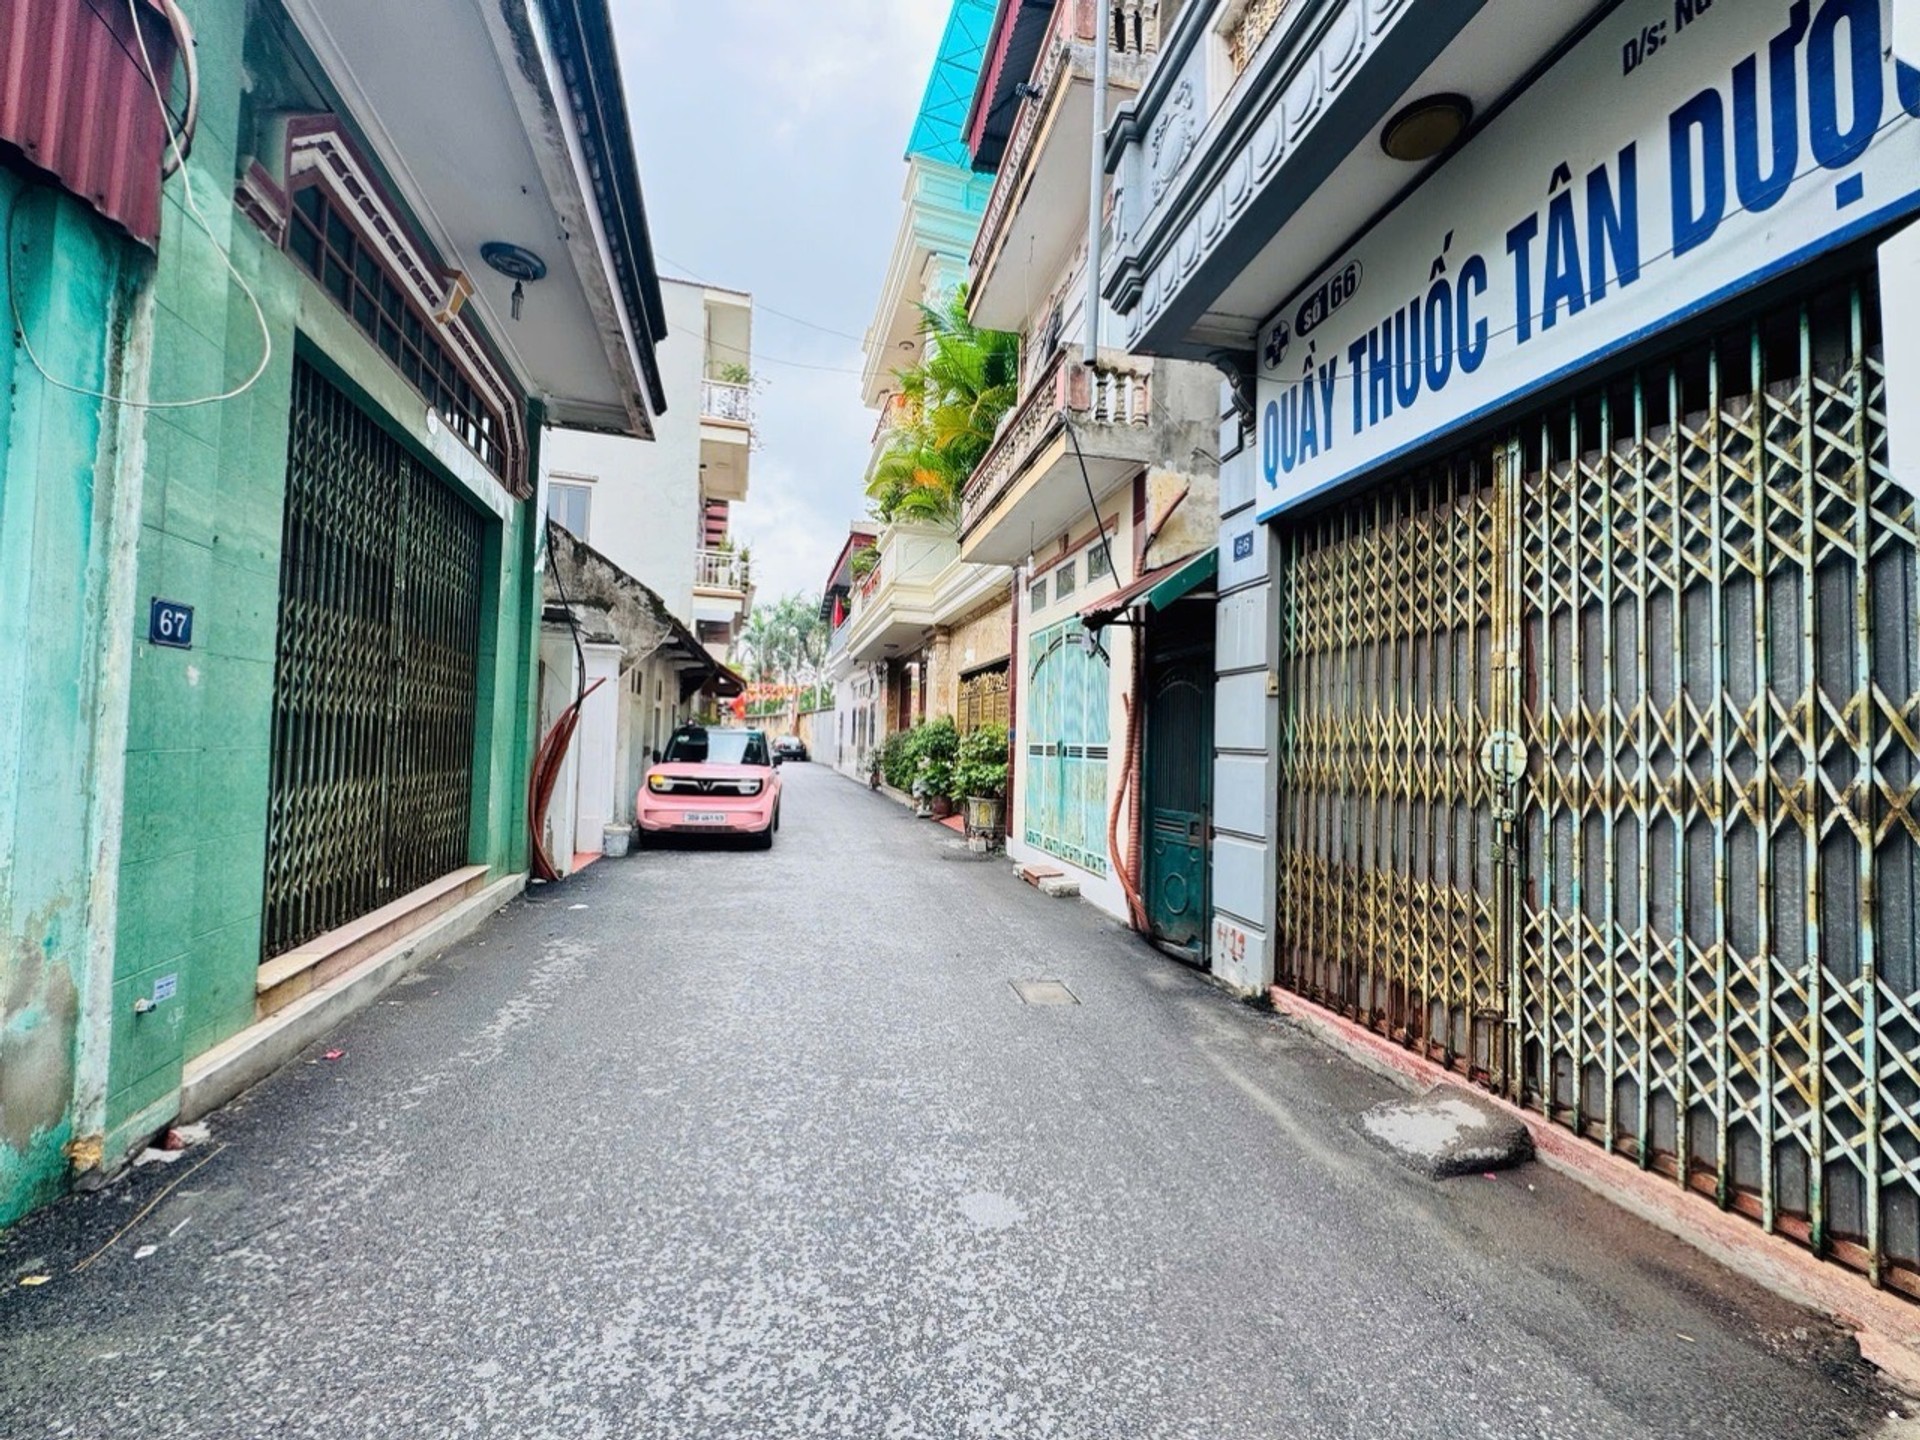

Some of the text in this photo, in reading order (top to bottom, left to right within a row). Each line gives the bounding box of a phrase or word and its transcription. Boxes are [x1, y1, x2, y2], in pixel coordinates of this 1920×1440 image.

[1263, 0, 1920, 491] QUẦY THUỐC TÂN DƯỢ
[1330, 264, 1356, 310] 66
[1235, 536, 1250, 556] 66
[160, 609, 188, 638] 67
